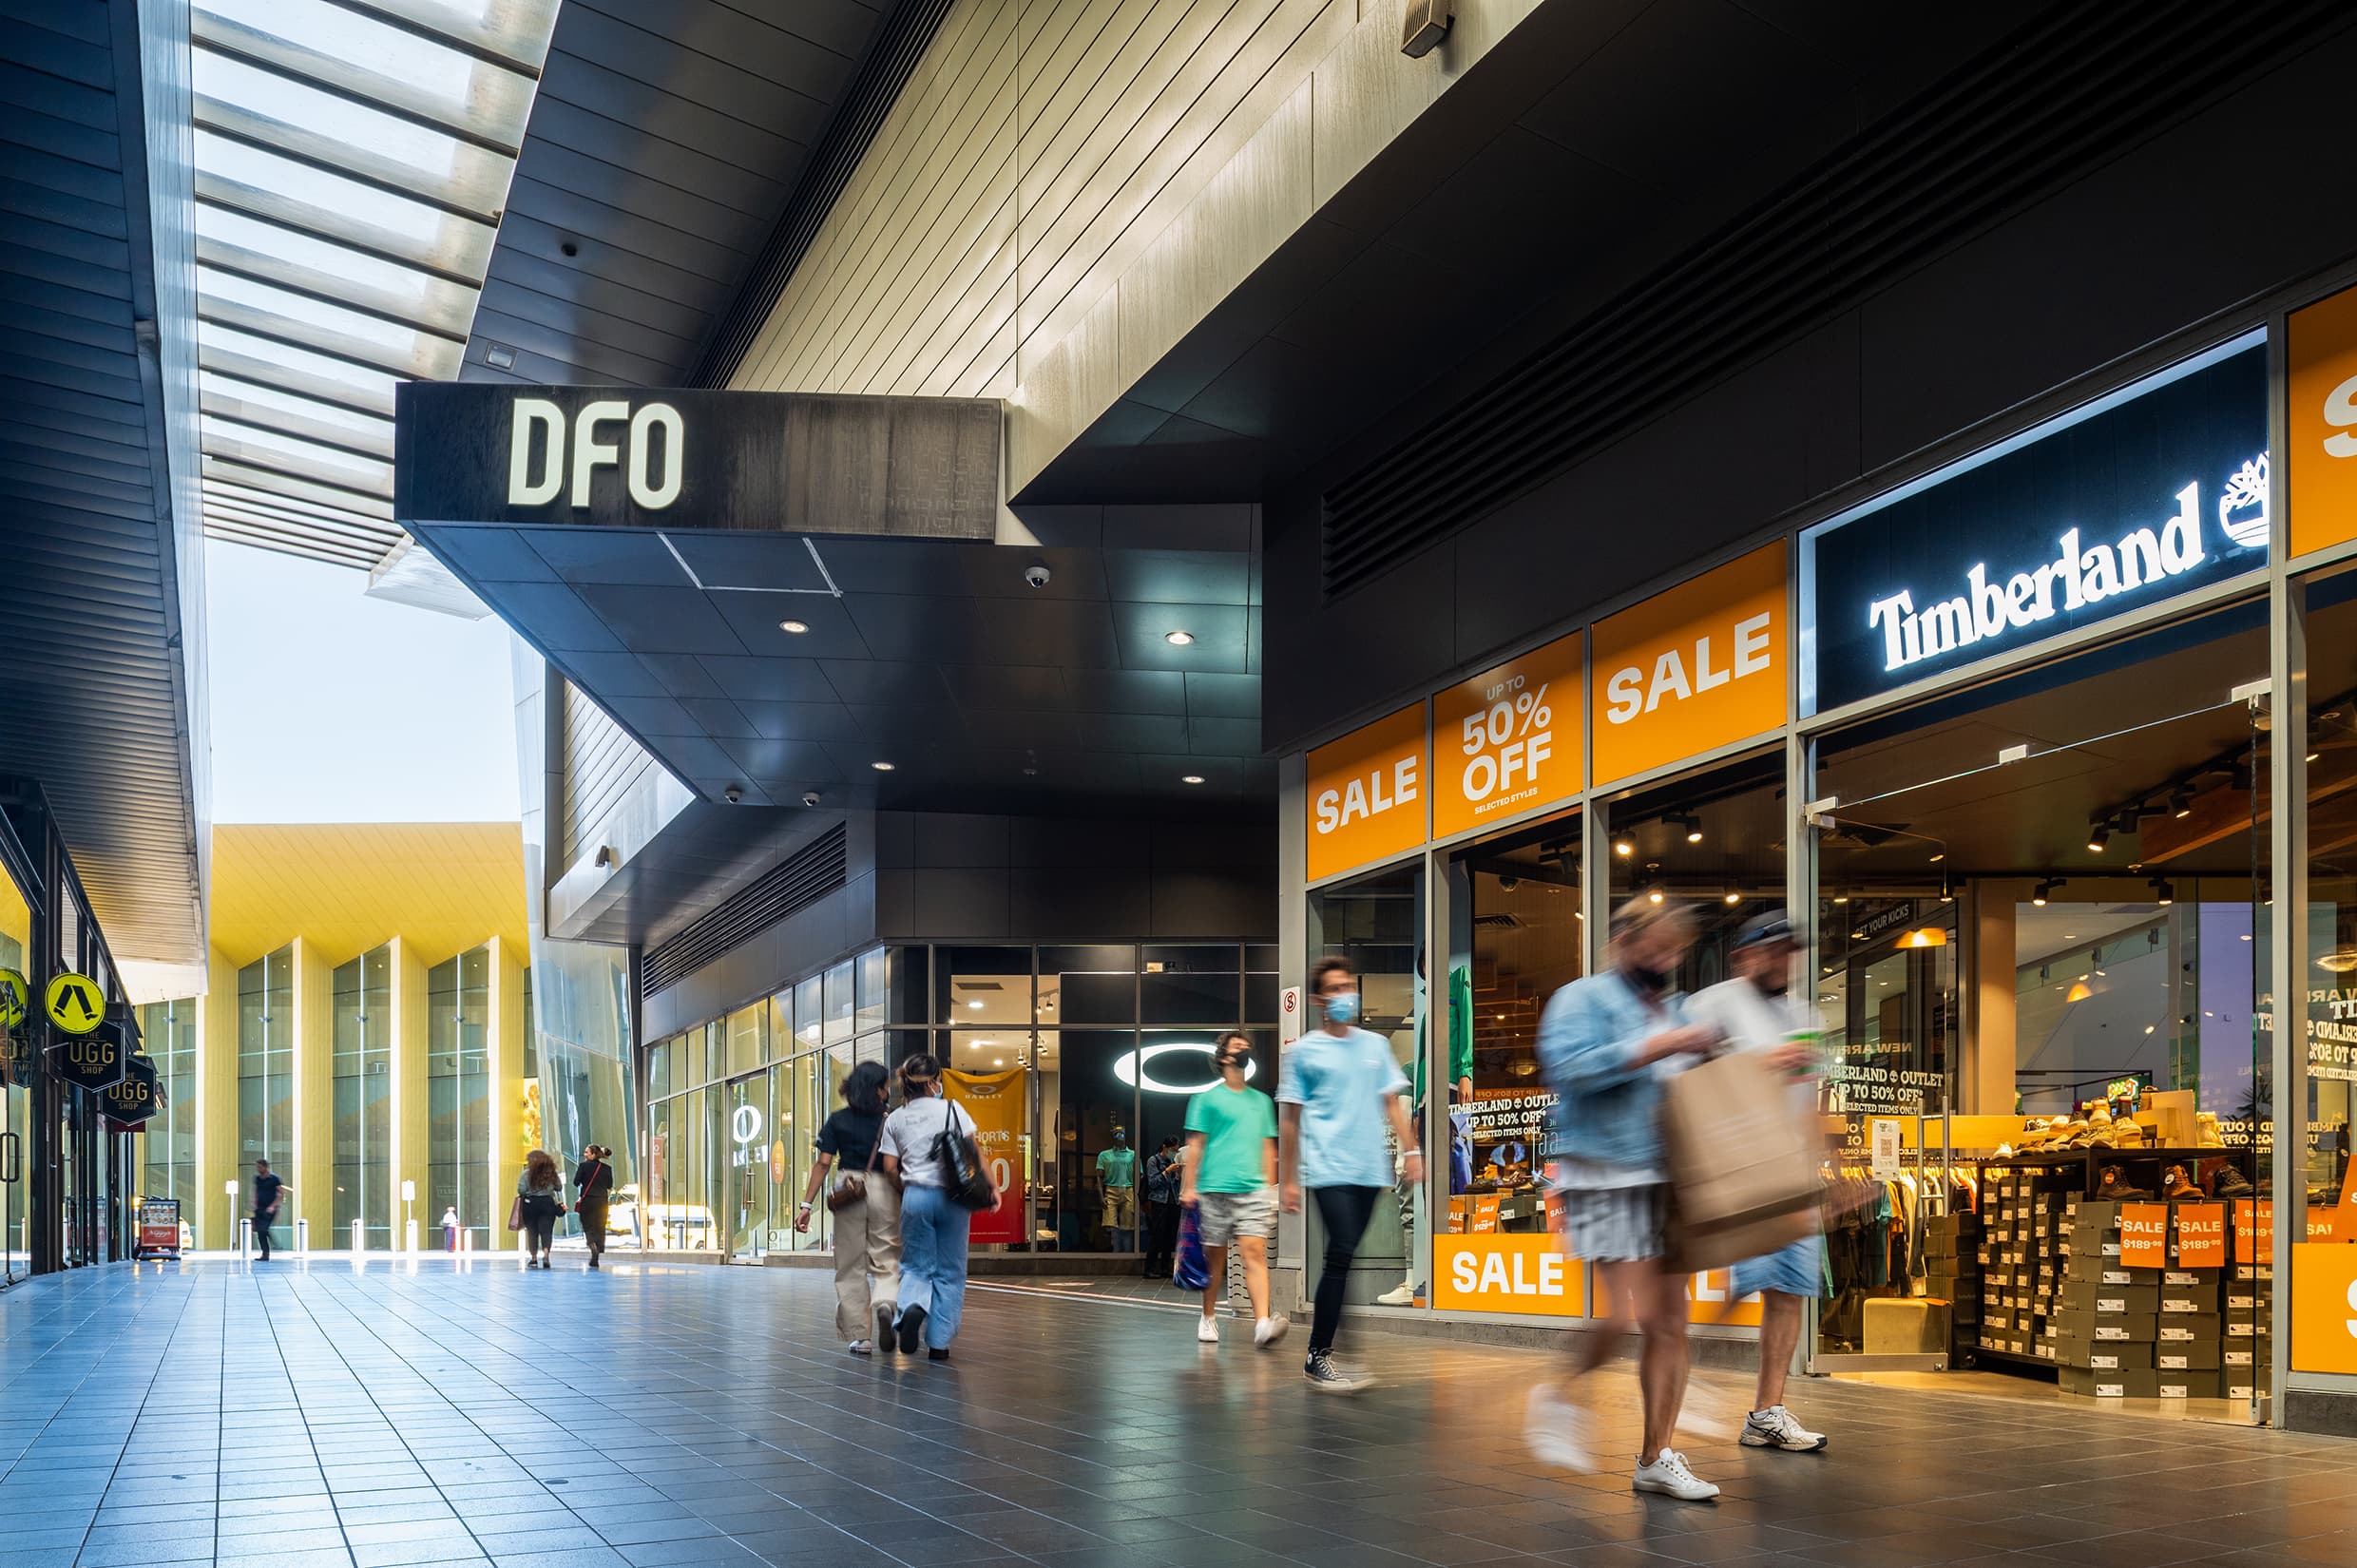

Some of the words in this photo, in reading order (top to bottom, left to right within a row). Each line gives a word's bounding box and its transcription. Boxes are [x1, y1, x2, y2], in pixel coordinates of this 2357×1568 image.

[508, 397, 684, 510] DFO
[1869, 481, 2206, 672] Timberland
[1607, 611, 1771, 725] SALE
[1486, 683, 1504, 701] UP
[1506, 675, 1525, 693] TO
[1463, 683, 1552, 755] 50%
[1463, 730, 1552, 801] OFF
[1316, 755, 1417, 834] SALE
[1474, 796, 1510, 814] SELECTED
[1510, 787, 1538, 803] STYLES
[1868, 915, 1888, 932] YOUR
[1888, 904, 1909, 925] KICKS
[69, 1042, 114, 1064] UGG
[81, 1065, 104, 1075] SHOP
[1900, 1071, 1944, 1087] OUTLET
[108, 1081, 148, 1100] UGG
[1852, 1084, 1868, 1100] TO
[1871, 1085, 1894, 1100] 50%
[1448, 1099, 1512, 1115] TIMBERLAND
[1523, 1094, 1560, 1108] OUTLE
[1878, 1104, 1899, 1115] ITEMS
[1900, 1105, 1918, 1115] ONLY
[1466, 1117, 1480, 1128] UP
[1481, 1115, 1495, 1127] TO
[1497, 1112, 1520, 1125] 50%
[1503, 1127, 1523, 1137] ITEMS
[1523, 1125, 1542, 1135] ONLY
[2122, 1221, 2163, 1233] SALE
[2180, 1220, 2221, 1233] SALE
[1452, 1252, 1564, 1296] SALE
